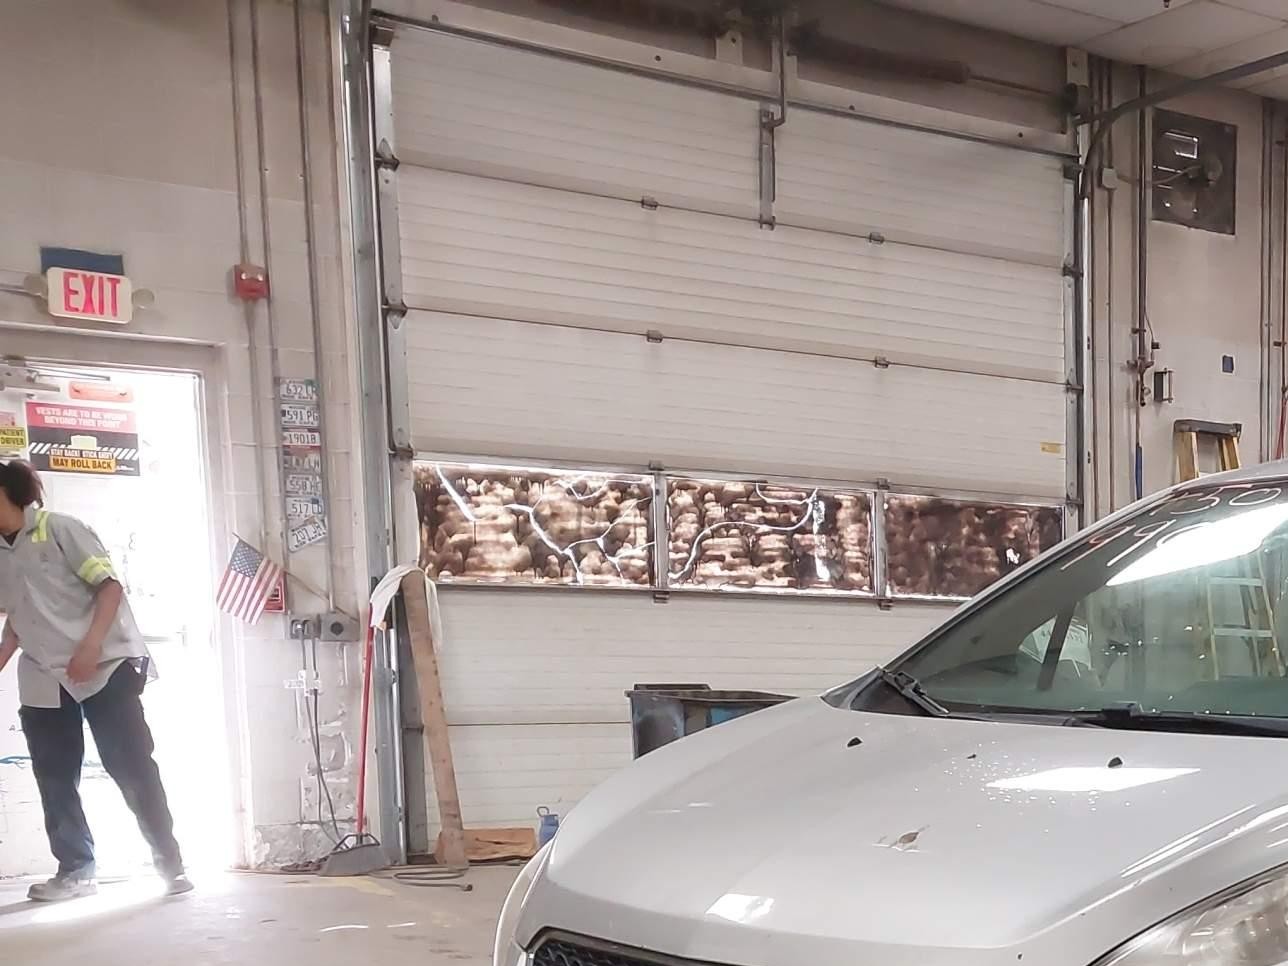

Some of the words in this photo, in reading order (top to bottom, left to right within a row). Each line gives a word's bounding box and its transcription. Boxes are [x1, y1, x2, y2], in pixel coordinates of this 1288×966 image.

[63, 271, 121, 317] EXIT
[52, 458, 69, 467] MAY
[71, 459, 91, 469] ROLL
[92, 461, 112, 470] BACK
